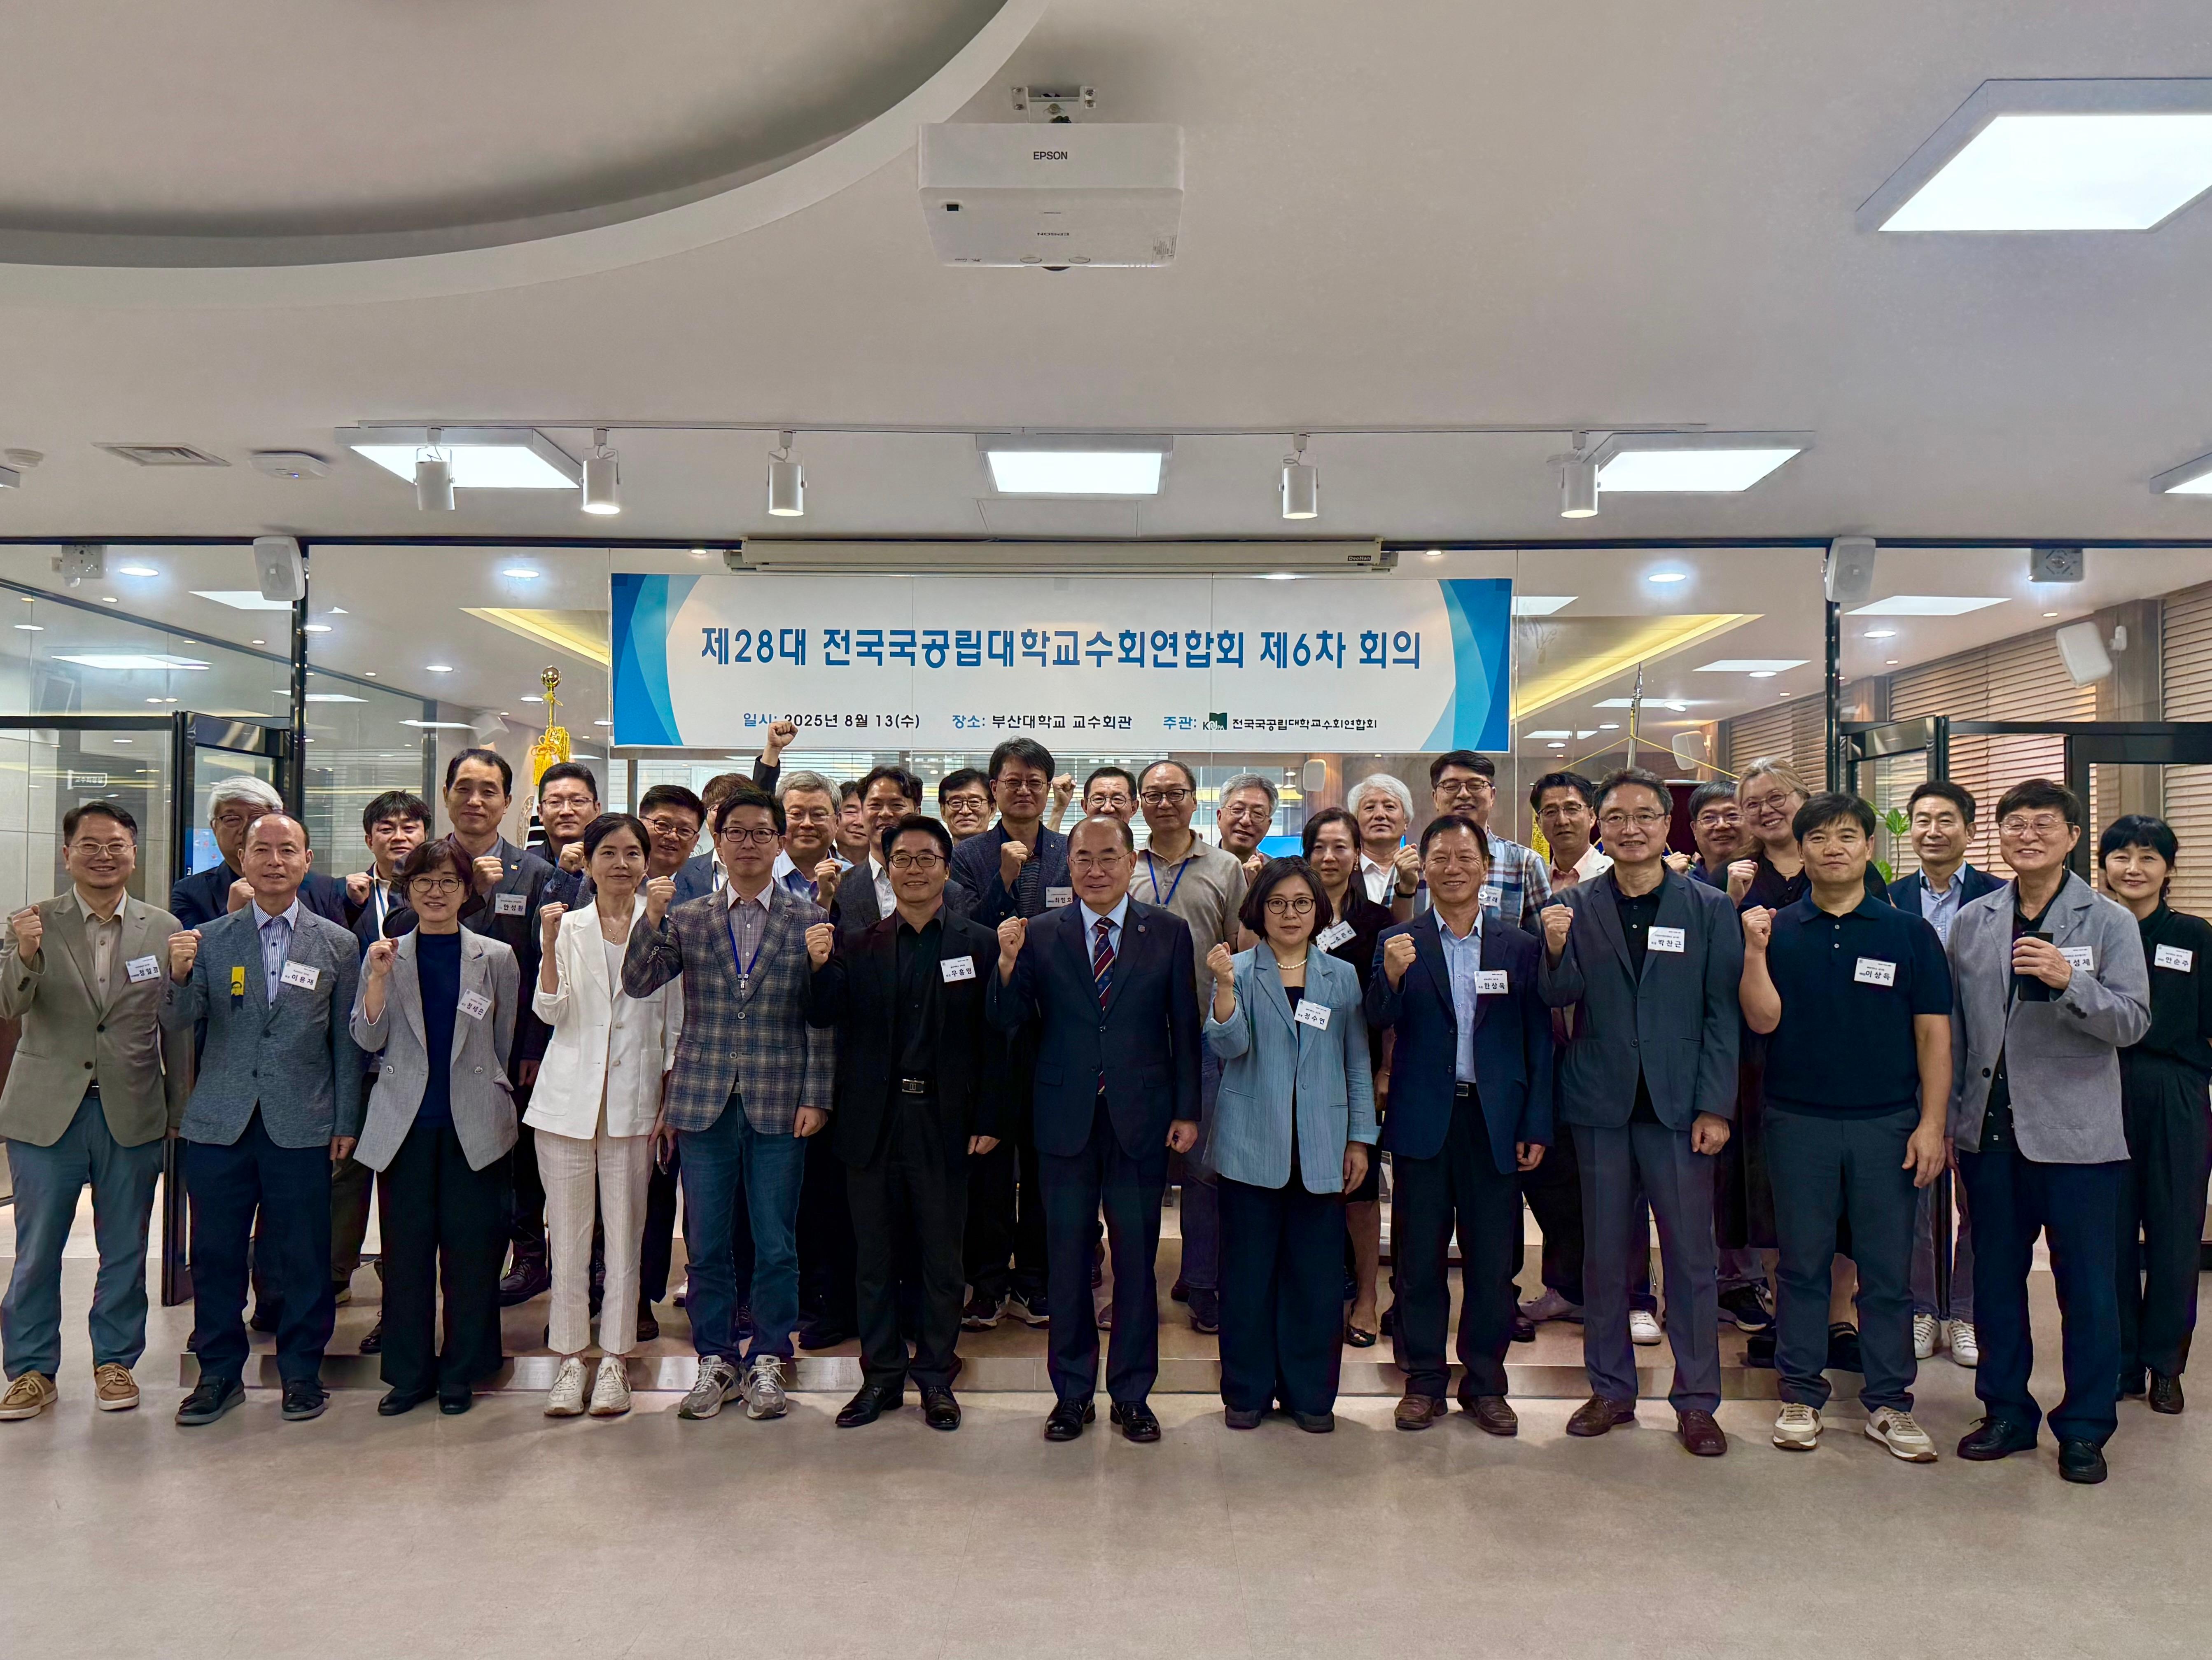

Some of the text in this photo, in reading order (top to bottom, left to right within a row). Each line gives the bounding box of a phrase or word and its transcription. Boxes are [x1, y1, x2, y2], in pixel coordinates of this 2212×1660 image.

[1034, 151, 1068, 160] EPSON
[702, 628, 1420, 669] 제28대 전국국공립대학교수회연합회 제6차 회의
[845, 714, 868, 728] 8월
[876, 714, 919, 729] 13(수)
[952, 715, 1132, 729] 장소: 부산대학교 교수회관
[1163, 717, 1197, 730] 주관:
[1233, 719, 1377, 731] 전국국공립대학교수회연합회
[1658, 939, 1681, 948] 박찬근
[2166, 957, 2189, 967] 안순주
[1865, 971, 1891, 981] 이상득
[1304, 1013, 1325, 1025] 정수연
